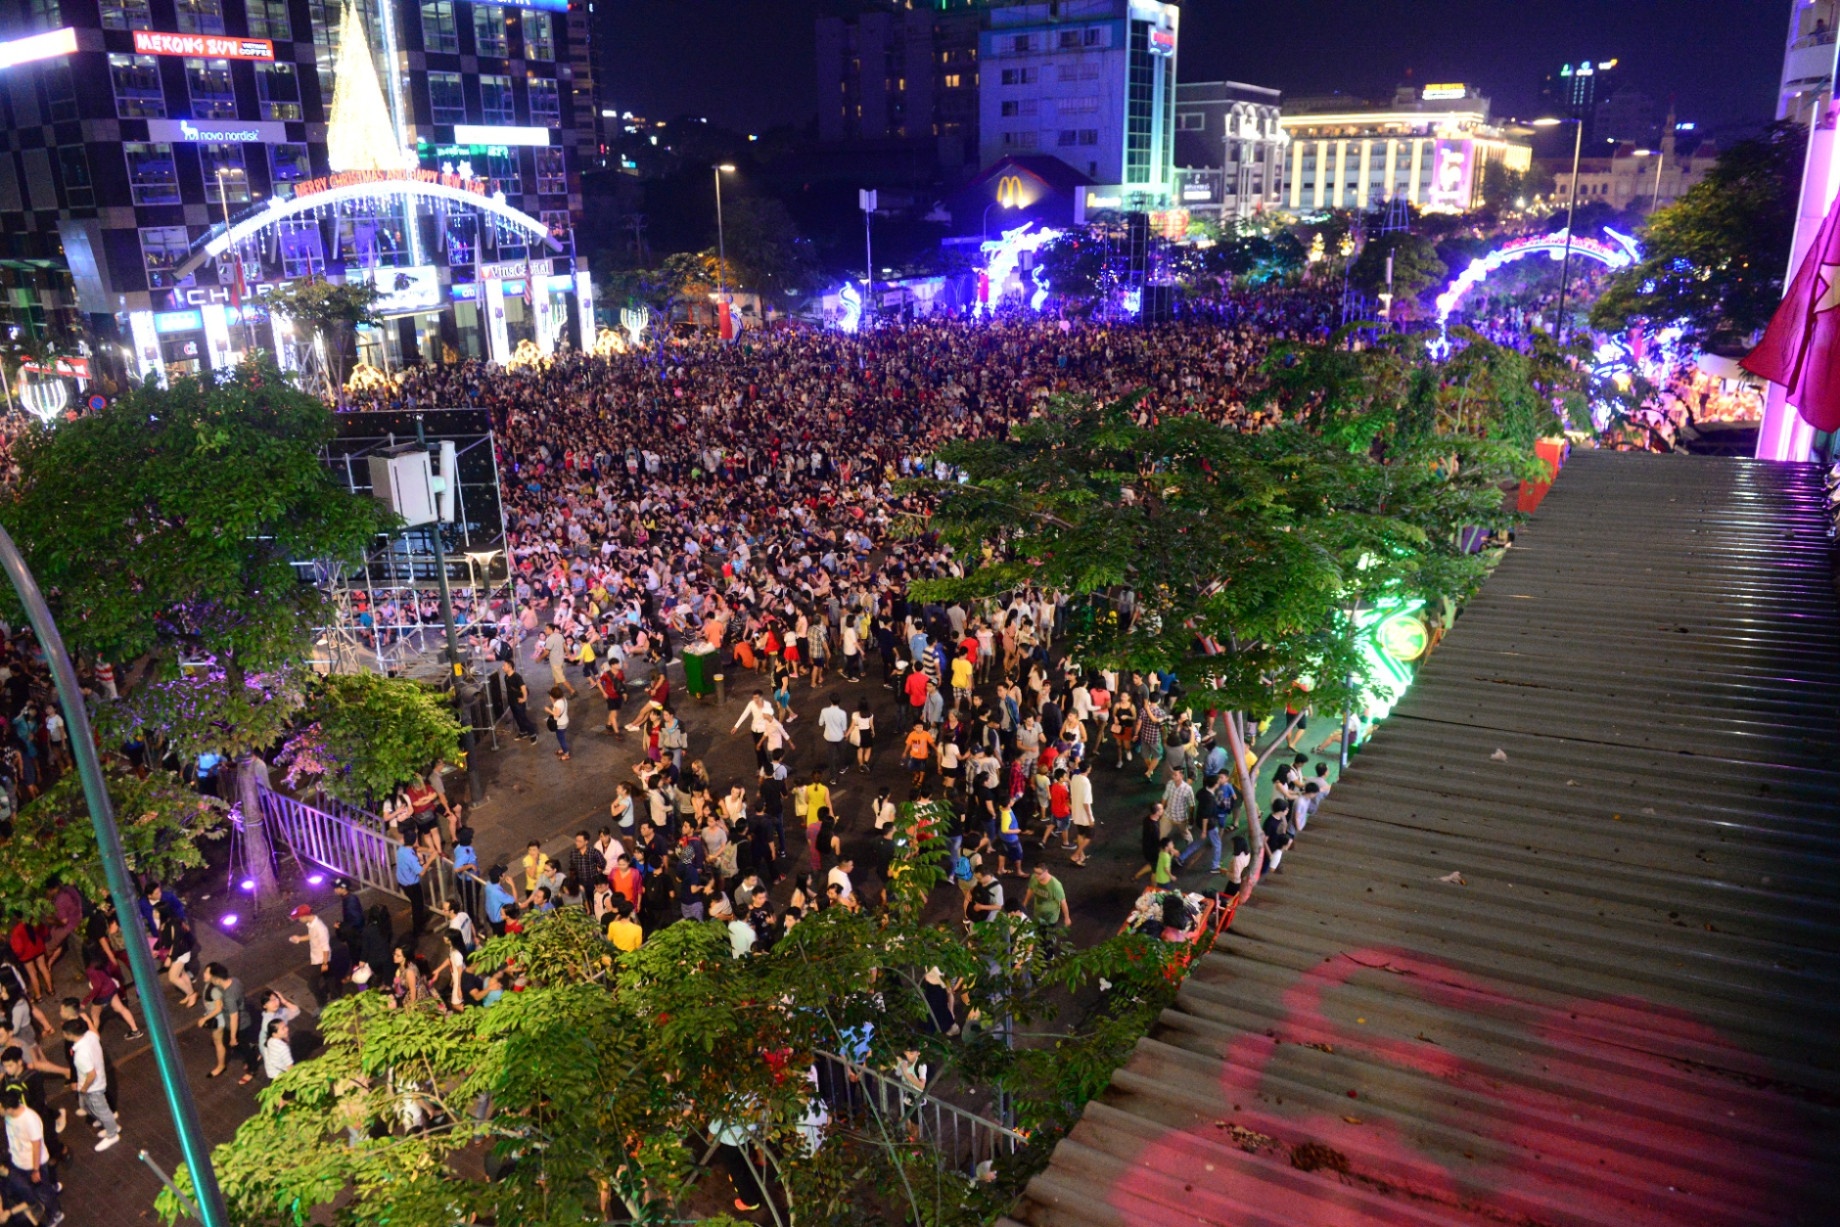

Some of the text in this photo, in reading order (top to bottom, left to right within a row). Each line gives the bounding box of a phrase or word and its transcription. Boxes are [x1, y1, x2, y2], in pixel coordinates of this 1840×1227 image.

[136, 33, 238, 56] MEKONG SUN
[200, 129, 258, 141] novo nordisk
[294, 177, 327, 198] MERRY
[329, 169, 385, 189] CHRISTMAS
[411, 167, 438, 185] HAPPY
[441, 172, 462, 189] NEW
[465, 178, 485, 196] YEAR
[490, 259, 550, 279] VinaCital
